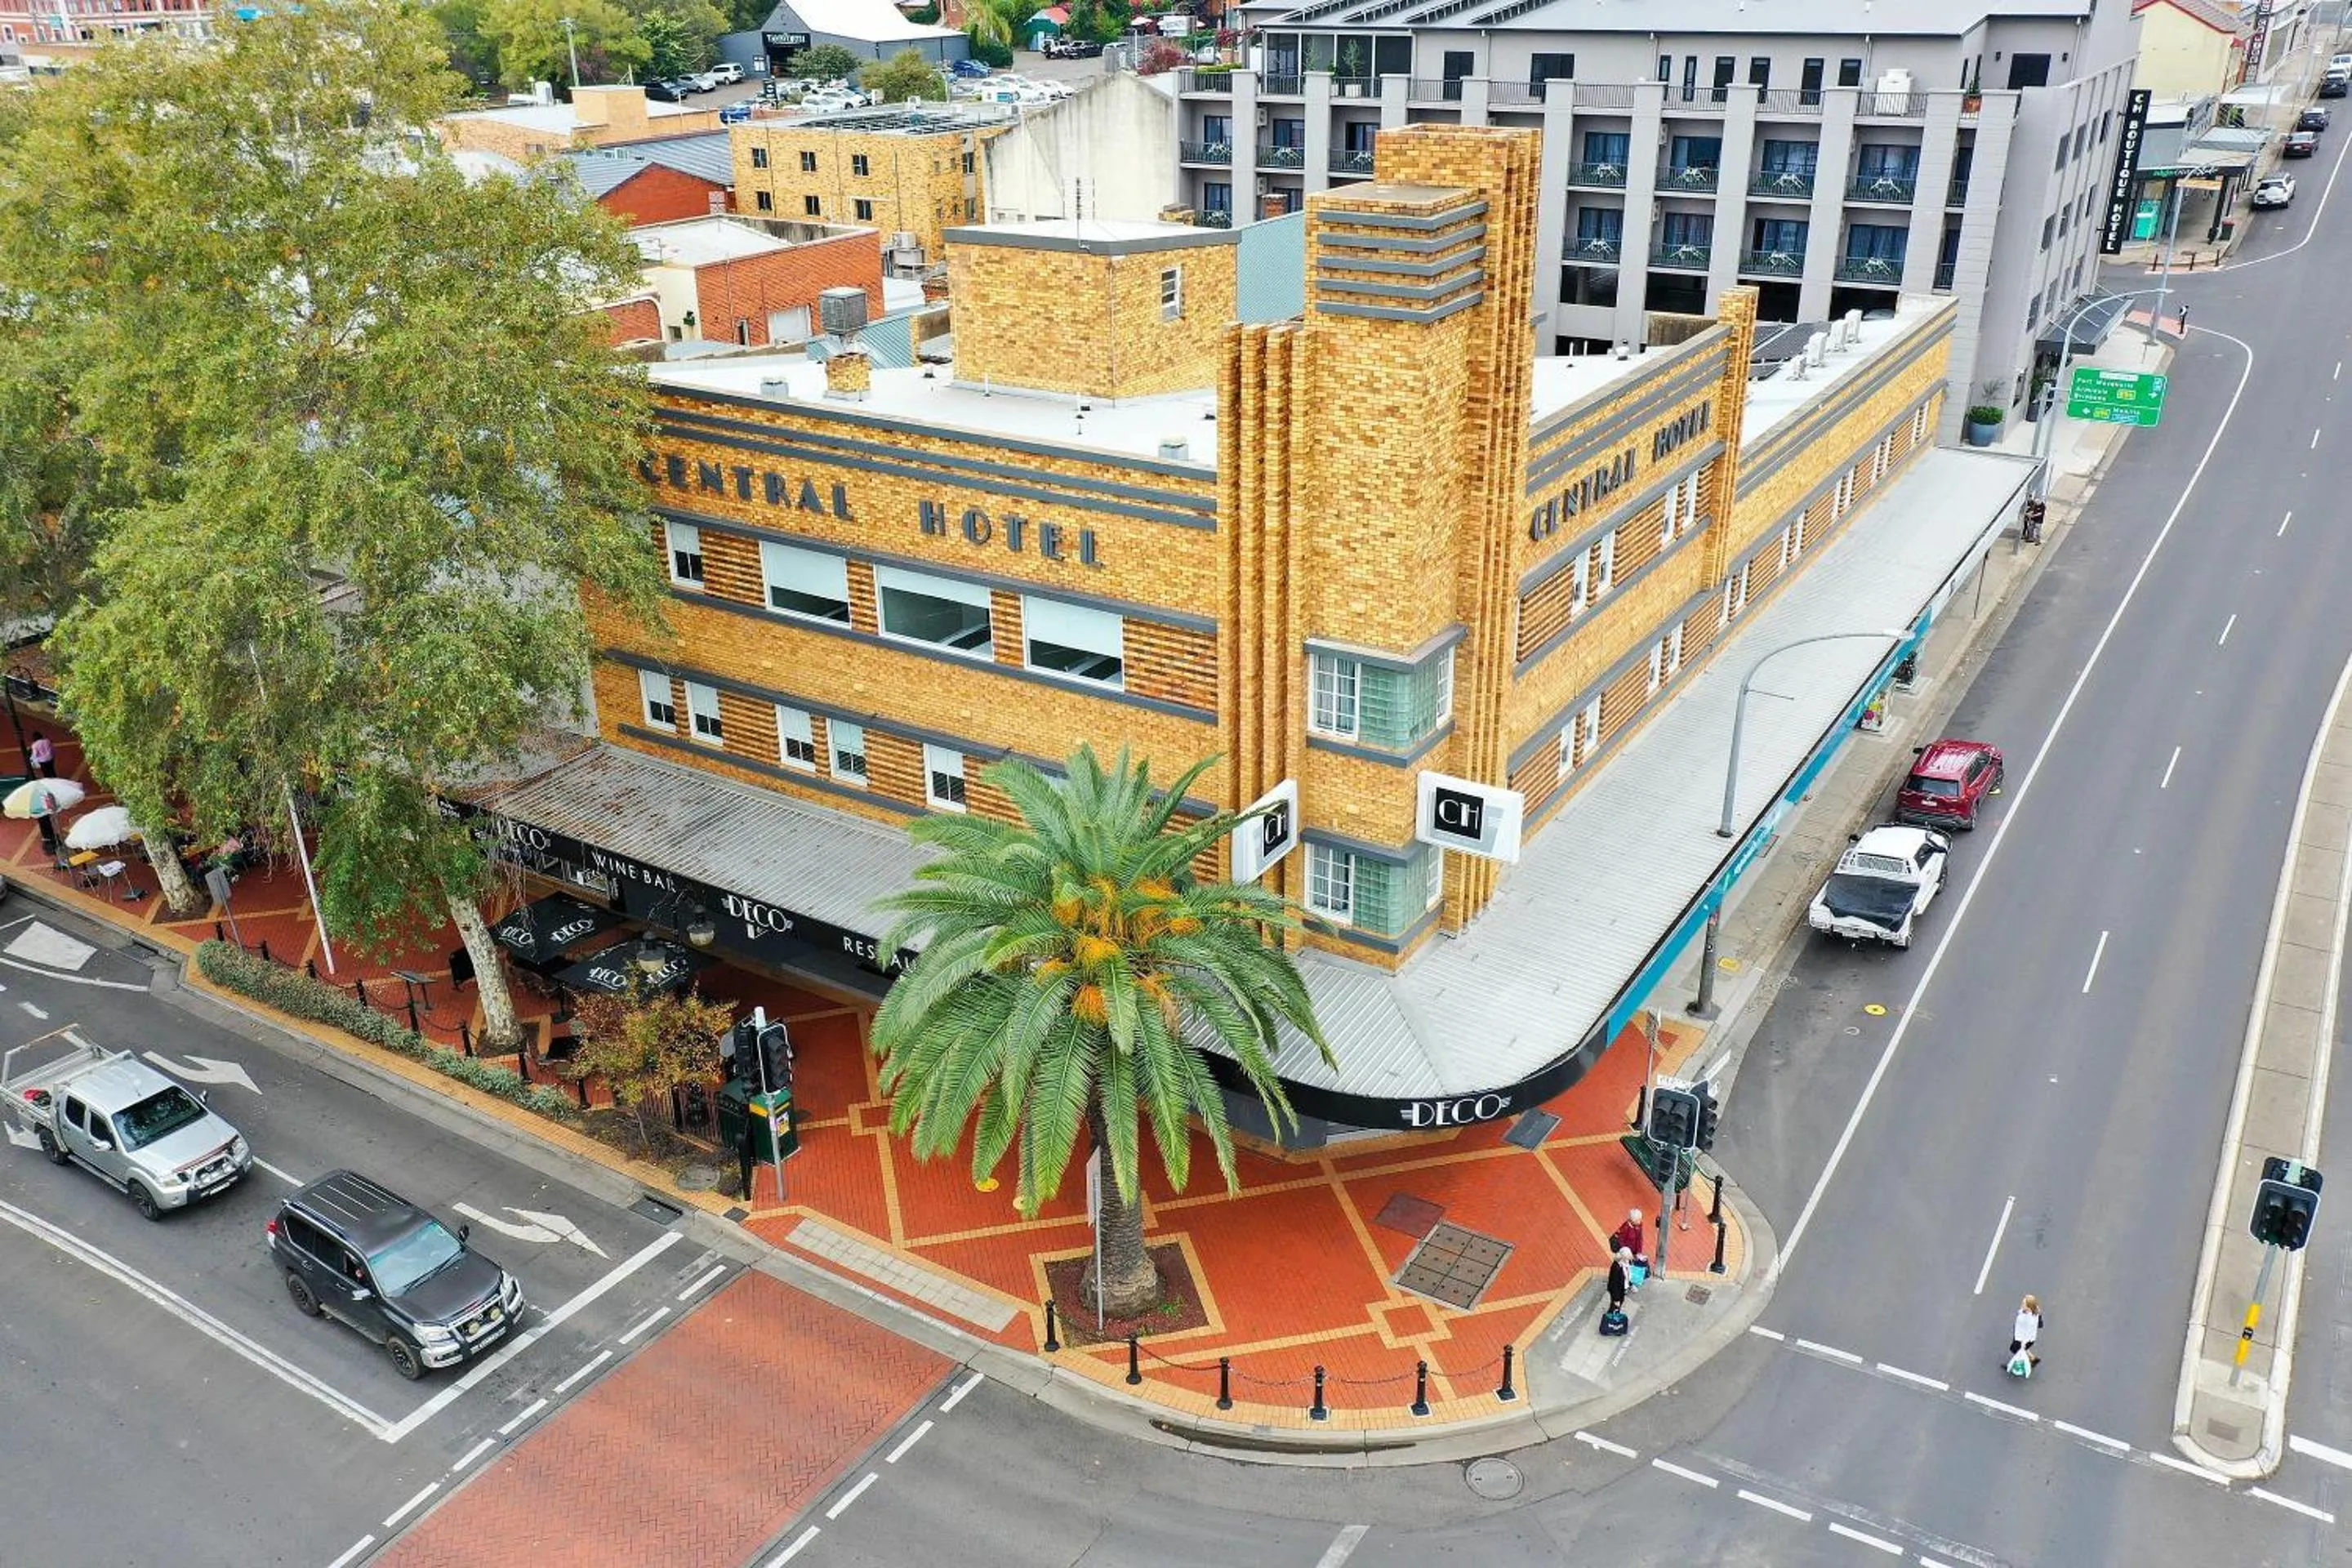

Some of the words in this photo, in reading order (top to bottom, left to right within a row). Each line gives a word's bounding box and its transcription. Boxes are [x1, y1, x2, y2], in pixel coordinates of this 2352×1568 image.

[2116, 120, 2139, 198] BOUTIQUE
[2105, 203, 2123, 251] HOTEL
[639, 450, 853, 521] CENTRAL
[918, 499, 1104, 572] HOTEL
[1530, 448, 1636, 542] CENTRAL
[1438, 798, 1480, 832] CH
[591, 851, 637, 880] WINE
[643, 869, 678, 893] BAR
[549, 920, 595, 942] DECO
[724, 893, 791, 933] DECO
[1405, 1093, 1507, 1128] DECO
